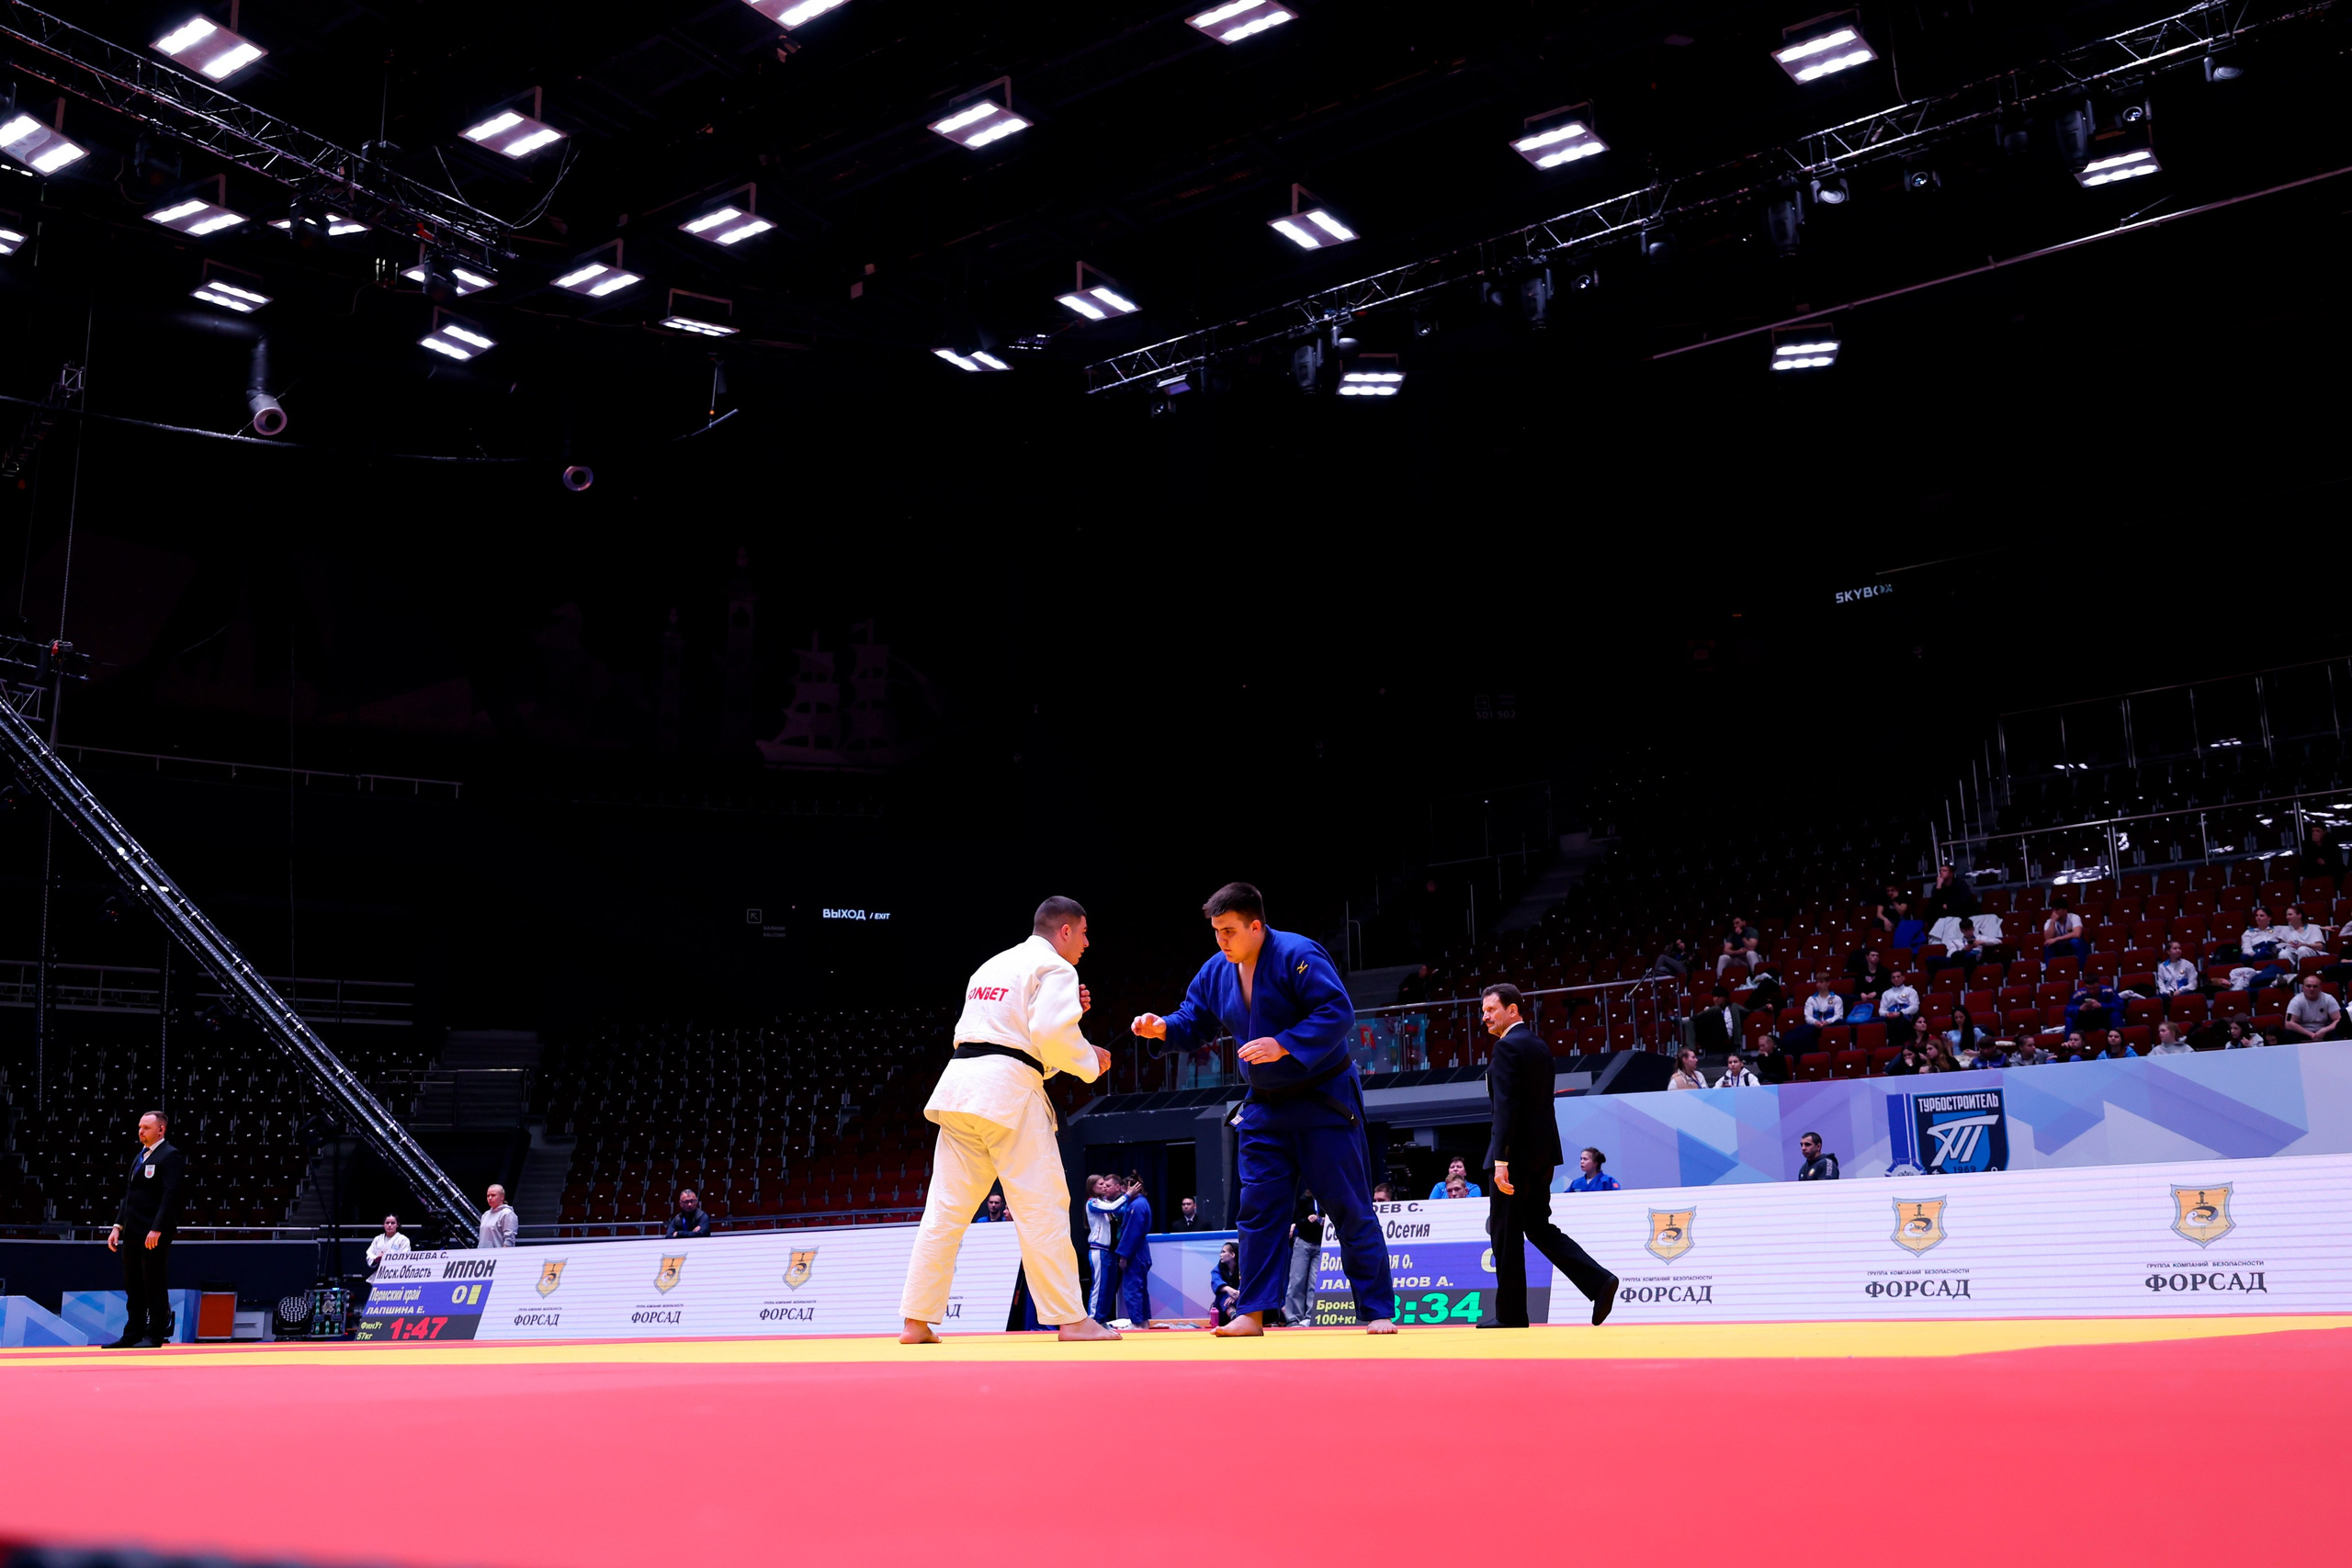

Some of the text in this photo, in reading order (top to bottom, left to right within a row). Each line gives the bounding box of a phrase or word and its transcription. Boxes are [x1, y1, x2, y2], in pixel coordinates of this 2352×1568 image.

[822, 908, 866, 920] ВЫХОД
[967, 987, 1010, 1002] ONBET
[1917, 1092, 1999, 1113] ТУРБОСТРОИТЕЛЬ
[1386, 1220, 1430, 1239] Осетия
[384, 1251, 449, 1261] ПОЛУЩЕВА С.
[443, 1259, 497, 1280] ИППОН
[1435, 1276, 1454, 1287] А.
[2145, 1272, 2267, 1294] ФОРСАД
[452, 1284, 468, 1304] 0
[1620, 1285, 1713, 1304] ФОРСАД
[1865, 1280, 1971, 1300] ФОРСАД
[366, 1305, 425, 1315] ЛАПШИНА Е.
[1316, 1299, 1355, 1313] Бронз
[514, 1314, 560, 1327] ФОРСАД
[631, 1311, 682, 1325] ФОРСАД
[759, 1307, 815, 1322] ФОРСАД
[390, 1316, 448, 1340] 1:47
